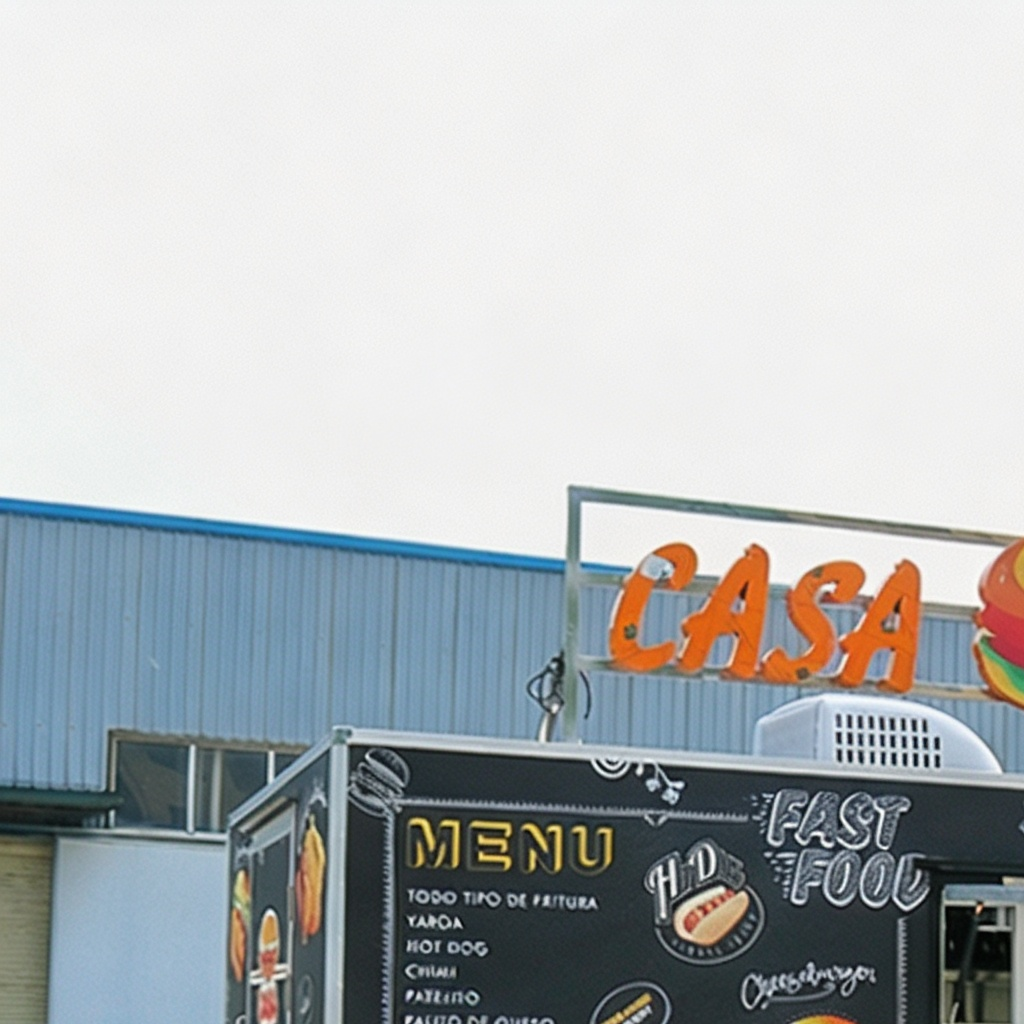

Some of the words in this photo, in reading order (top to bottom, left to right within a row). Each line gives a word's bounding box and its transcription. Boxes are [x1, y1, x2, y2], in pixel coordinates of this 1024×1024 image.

[609, 541, 922, 694] CASA
[405, 817, 614, 876] MENU
[767, 788, 912, 850] FAST
[407, 888, 457, 905] TODO
[463, 891, 502, 908] TIPO
[507, 892, 527, 909] DE
[406, 939, 441, 955] HOT
[447, 941, 489, 957] DOG
